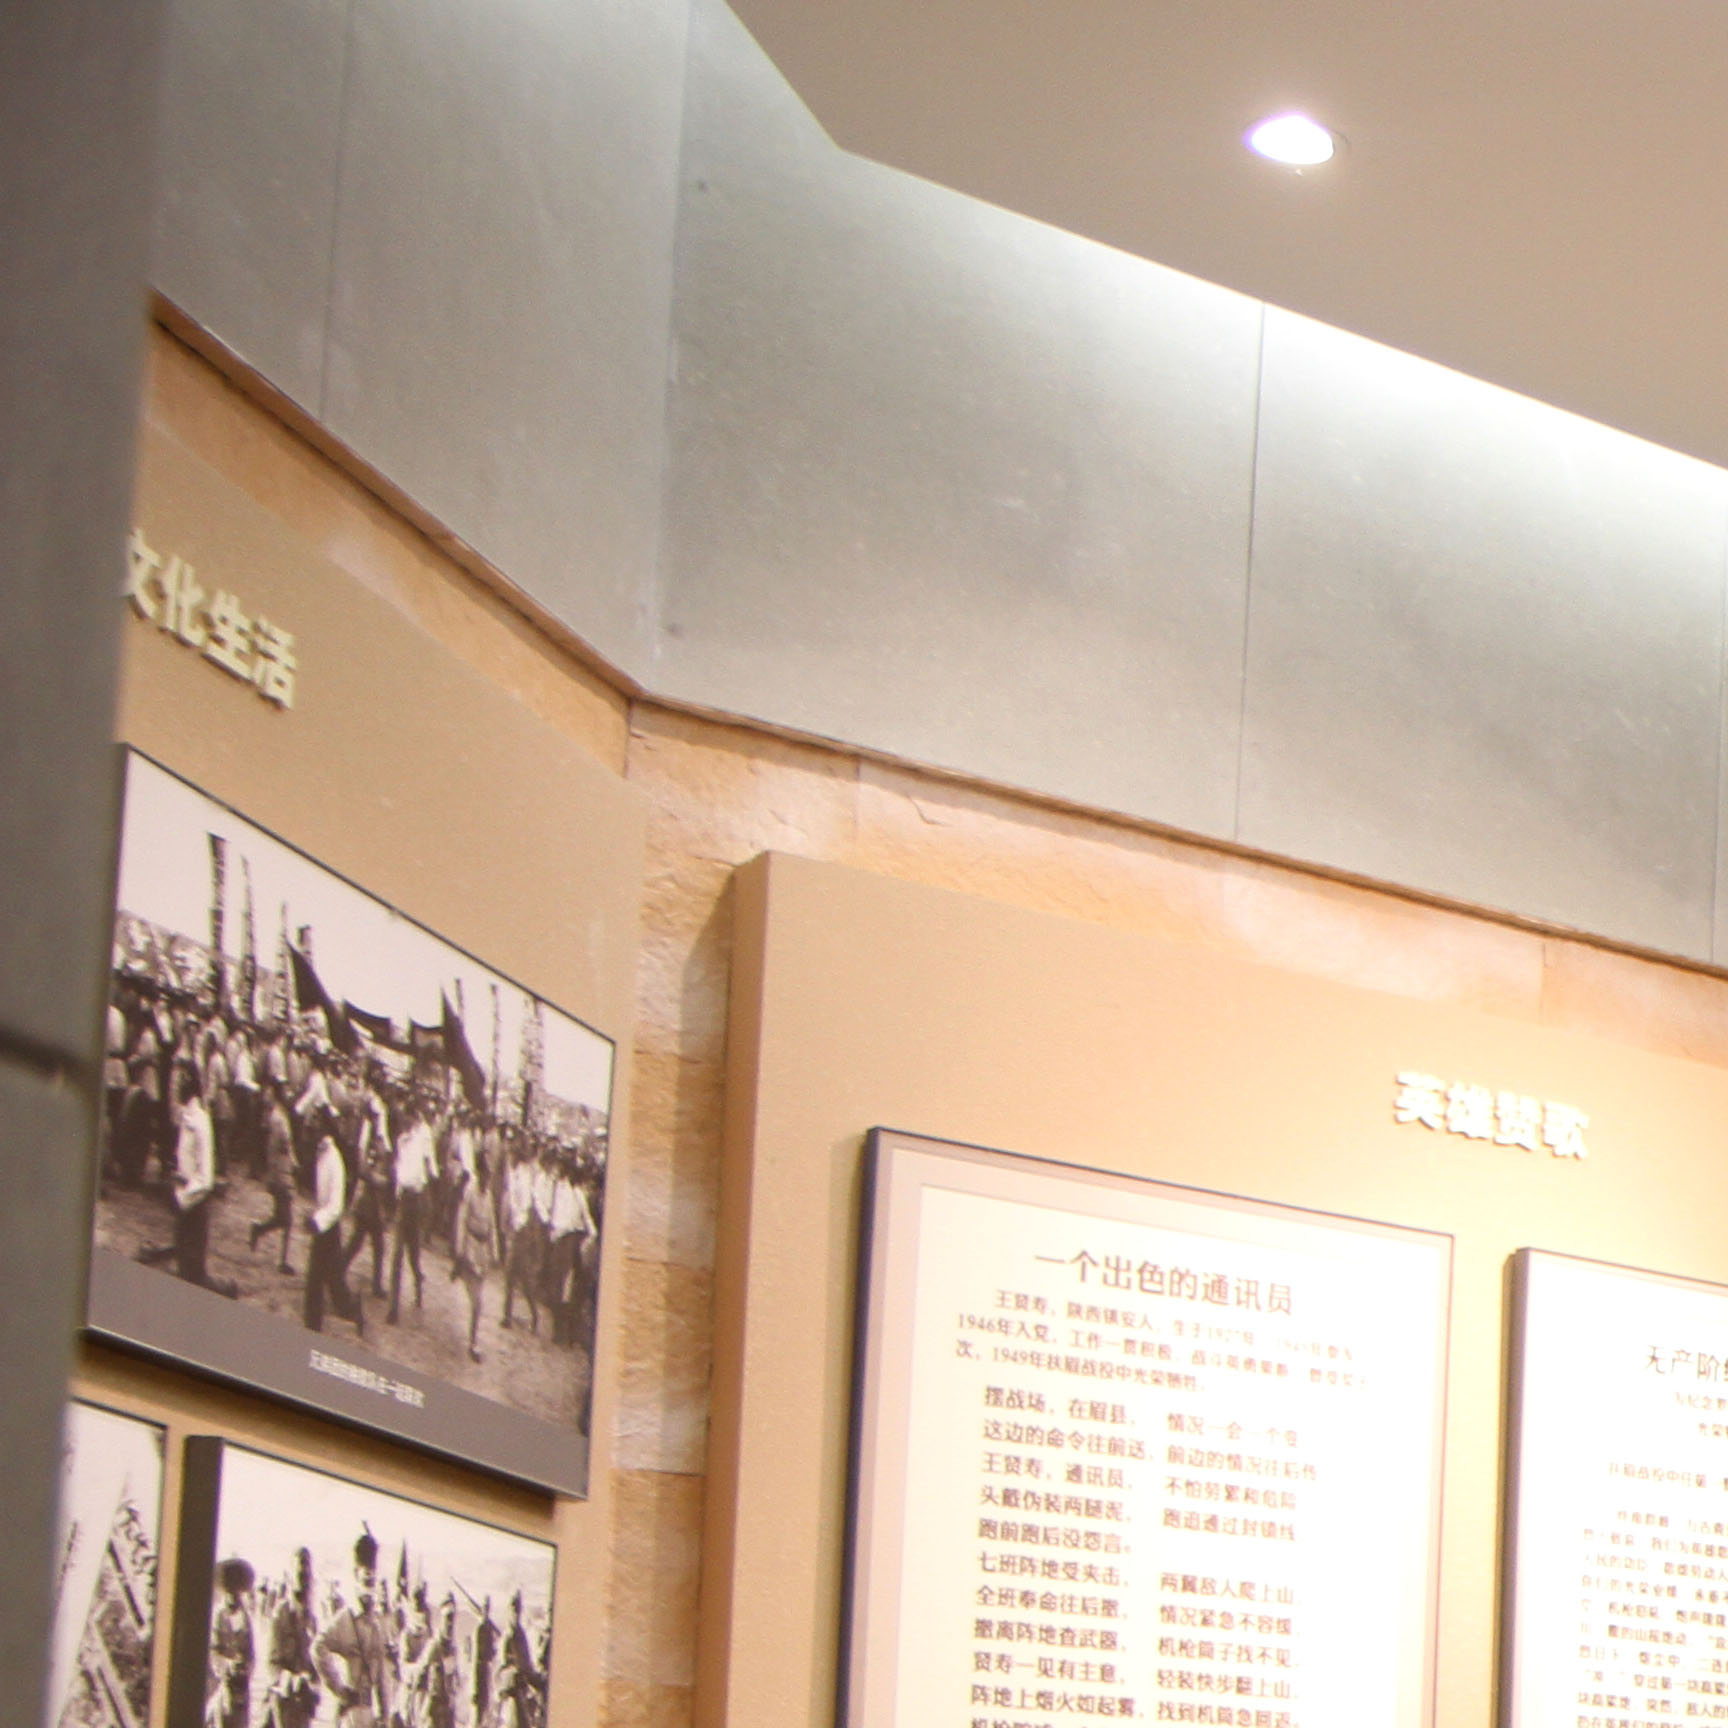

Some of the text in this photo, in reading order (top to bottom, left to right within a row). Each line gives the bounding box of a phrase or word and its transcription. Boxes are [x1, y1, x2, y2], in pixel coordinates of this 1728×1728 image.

[126, 527, 296, 711] 文化生活
[1033, 1249, 1293, 1315] 一个出色的通讯员
